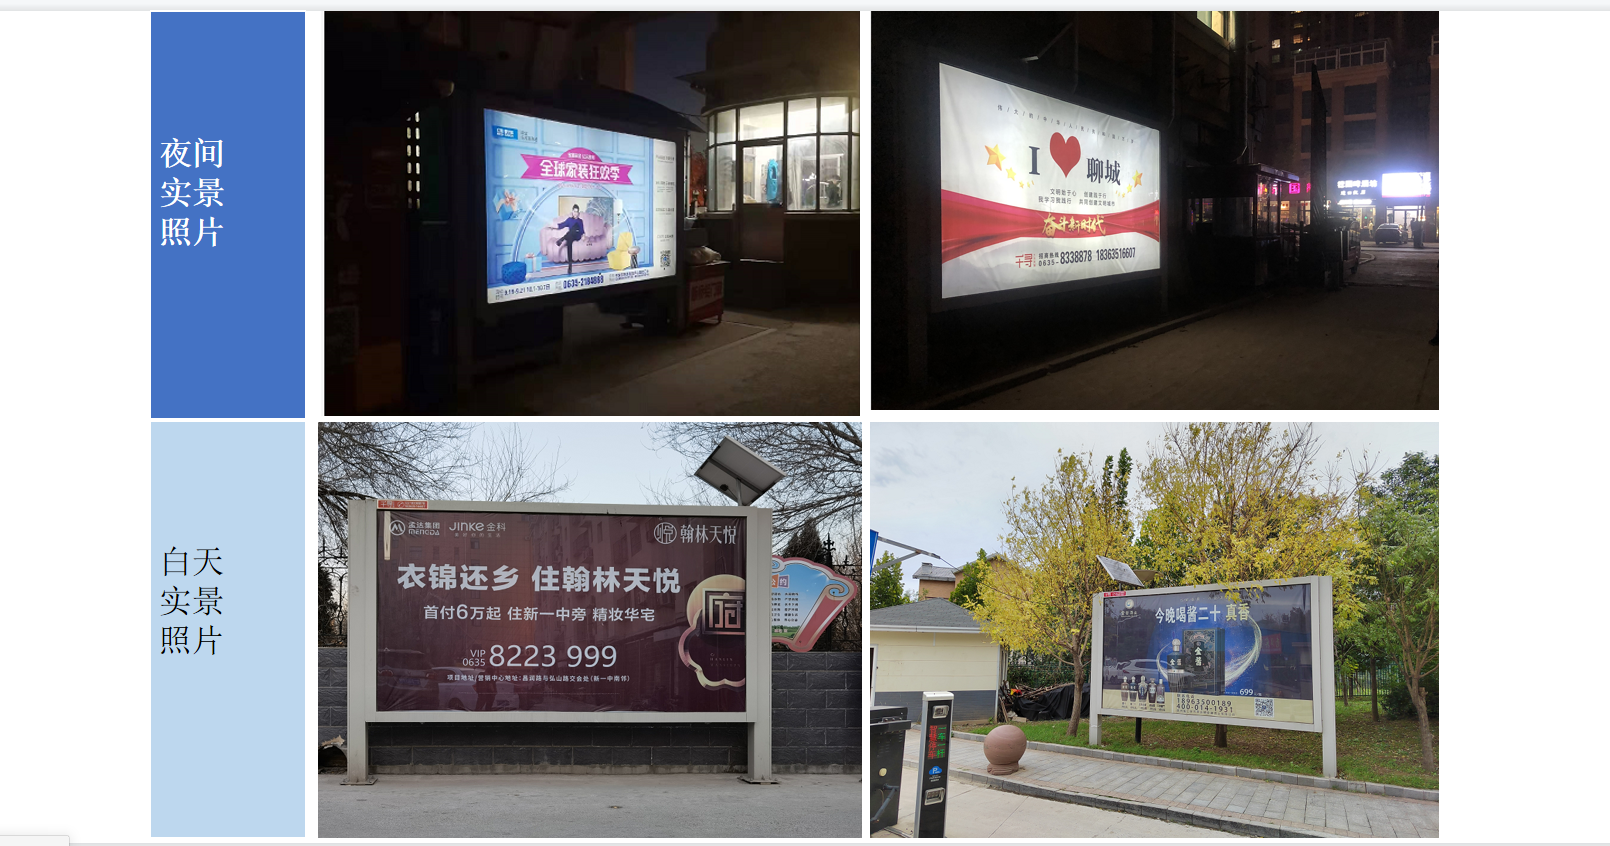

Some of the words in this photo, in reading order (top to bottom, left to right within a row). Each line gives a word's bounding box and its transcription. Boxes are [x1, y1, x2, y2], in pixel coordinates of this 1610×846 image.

[539, 159, 621, 181] 全球家装狂欢季
[1028, 146, 1041, 176] I
[1086, 157, 1121, 186] 聊城
[1042, 214, 1107, 238] 奋斗新时代
[1015, 253, 1033, 269] 千寻
[1038, 252, 1060, 260] 招商热线
[1060, 250, 1092, 265] 8338878
[1096, 247, 1136, 262] 18363516607
[408, 521, 441, 530] 孟达集团
[486, 522, 506, 532] 金科
[680, 524, 737, 545] 翰林天悦
[397, 563, 519, 591] 衣锦还乡
[531, 565, 681, 594] 住翰林天悦
[423, 604, 501, 621] 首付6万起
[507, 606, 587, 622] 住新一中旁
[592, 607, 655, 622] 精妆华宅
[1155, 604, 1221, 624] 今晚喝酱二十
[1225, 602, 1250, 622] 真香
[462, 658, 486, 667] 0635
[489, 644, 556, 668] 8223
[566, 645, 617, 668] 999
[470, 649, 486, 658] VIP
[1239, 688, 1254, 696] 699
[1176, 698, 1232, 708] 18963500189
[1176, 703, 1233, 714] 400-014-1931
[937, 726, 947, 758] 一车一杆
